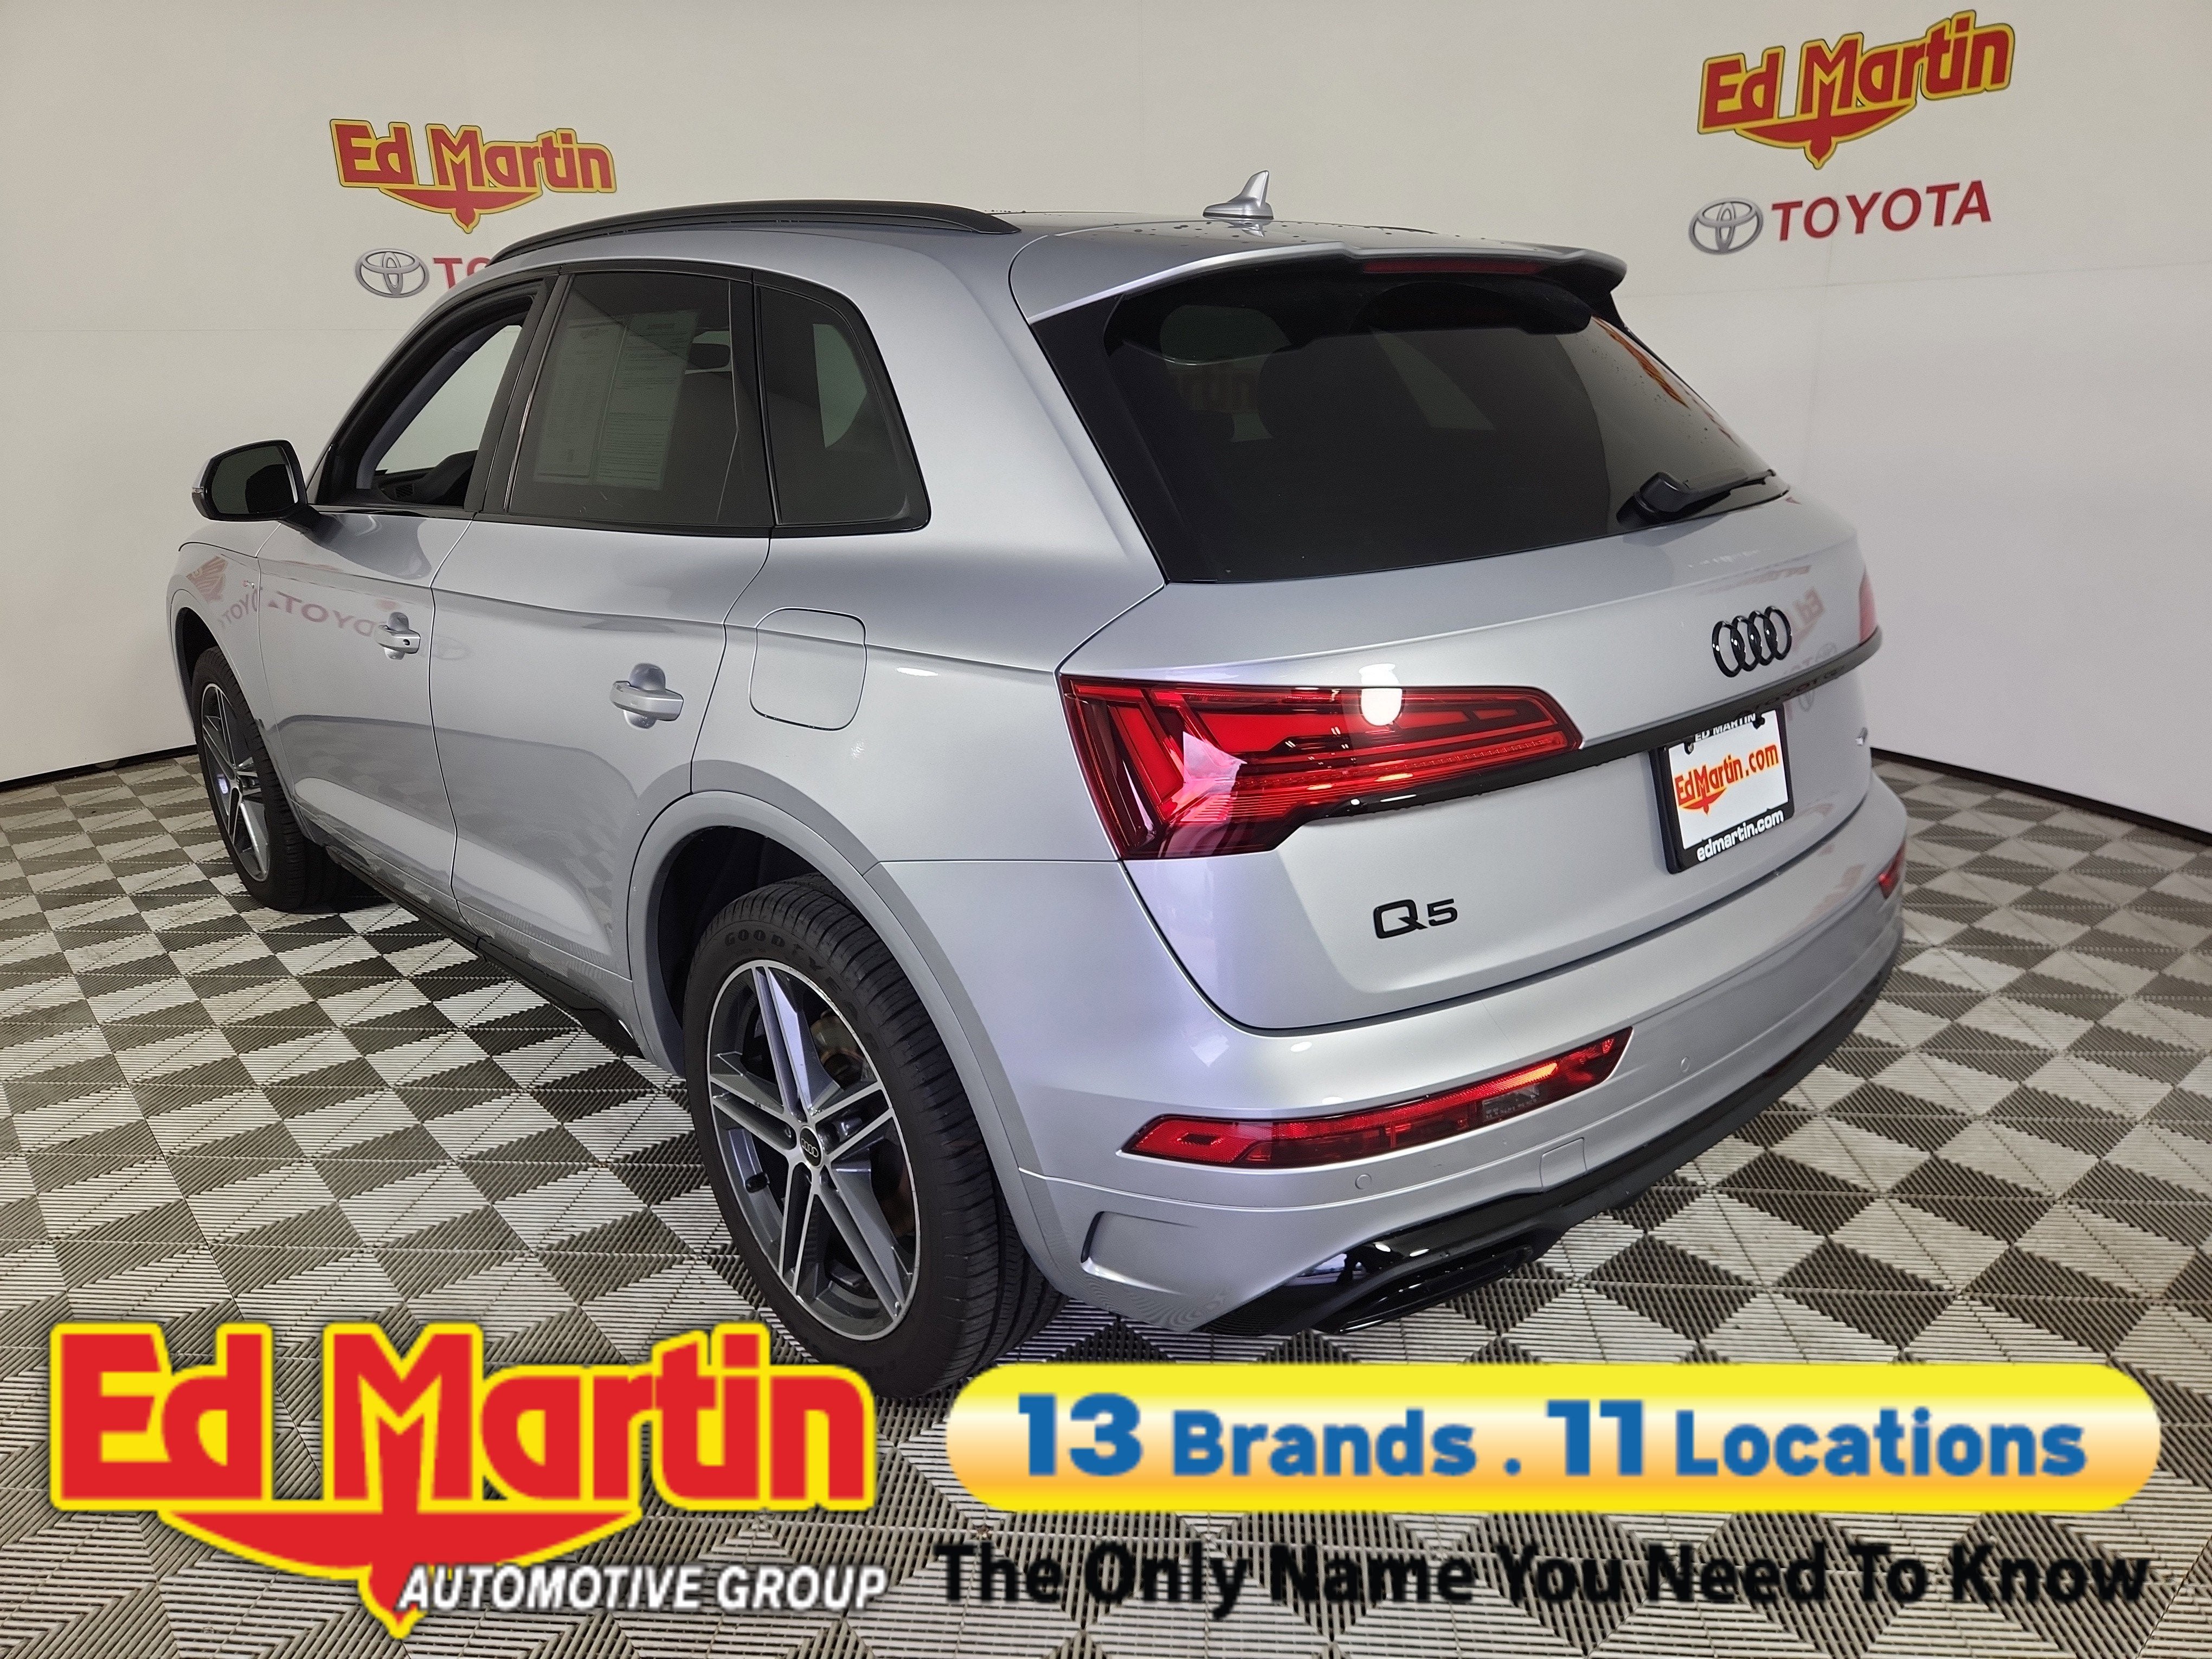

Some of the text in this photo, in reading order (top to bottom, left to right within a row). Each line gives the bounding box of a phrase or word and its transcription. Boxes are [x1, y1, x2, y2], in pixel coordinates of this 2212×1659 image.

[1700, 12, 2012, 130] Ed Martin
[332, 120, 615, 191] Ed Martin
[1771, 179, 1992, 241] TOYOTA
[1694, 729, 1711, 742] ED
[1674, 744, 1779, 802] EdMartin.com
[1696, 809, 1784, 862] edmartin.com
[1373, 898, 1458, 939] Q5
